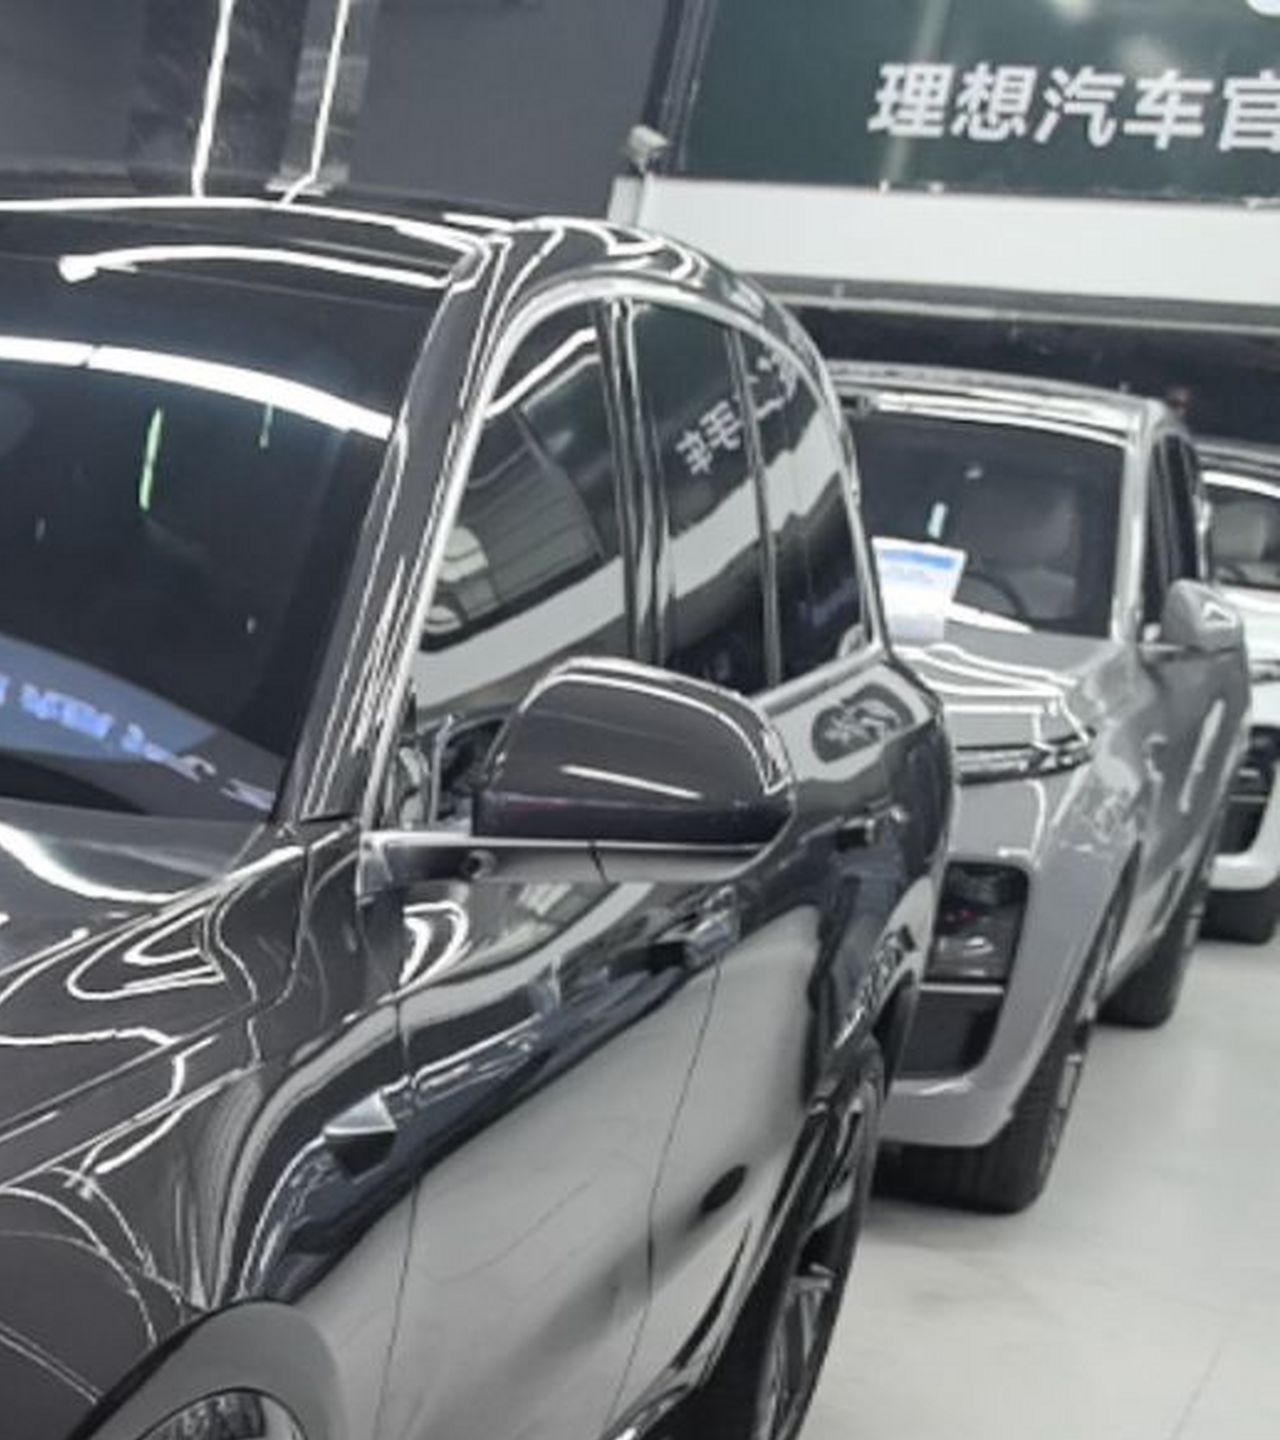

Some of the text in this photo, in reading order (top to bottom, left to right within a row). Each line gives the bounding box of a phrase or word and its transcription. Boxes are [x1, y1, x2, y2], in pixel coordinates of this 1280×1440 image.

[867, 61, 1280, 152] 理想汽车官
